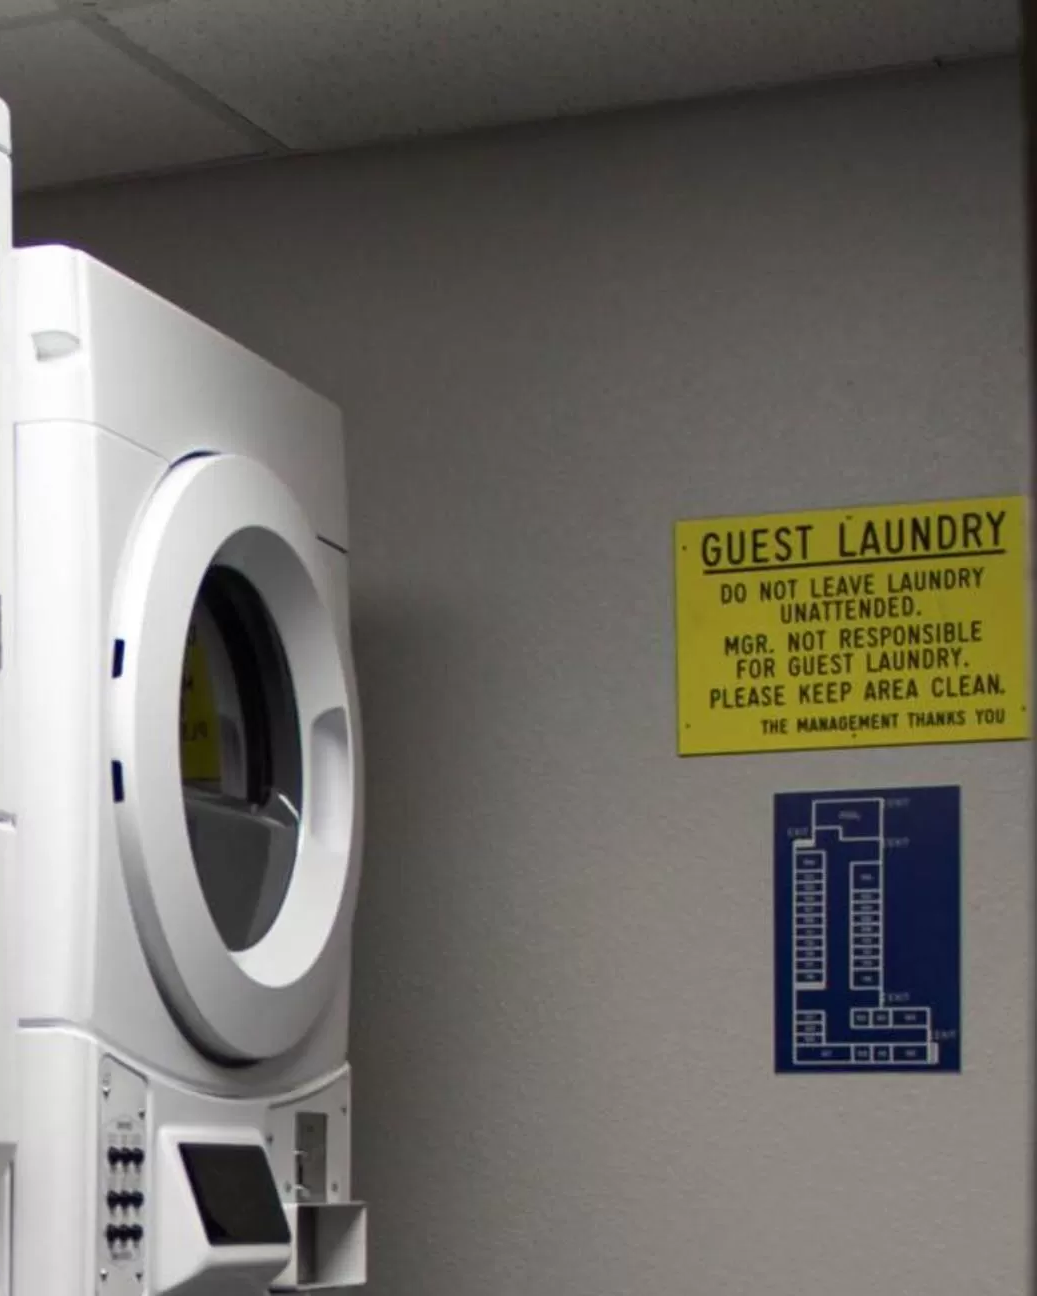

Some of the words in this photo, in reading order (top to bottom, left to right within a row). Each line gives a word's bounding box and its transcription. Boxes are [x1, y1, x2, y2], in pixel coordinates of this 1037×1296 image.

[701, 525, 813, 567] GUEST
[839, 511, 1006, 557] LAUNDRY
[720, 583, 747, 605] DO
[759, 579, 798, 602] NOT
[810, 574, 875, 599] LEAVE
[887, 566, 985, 595] LAUNDRY
[780, 596, 922, 624] UNATTENDED.
[724, 634, 775, 656] MGR.
[787, 630, 827, 652] NOT
[839, 620, 983, 649] RESPONSIBLE
[736, 658, 776, 680] FOR
[787, 653, 854, 677] GUEST
[866, 648, 970, 673] LAUNDRY.
[709, 685, 786, 709] PLEASE
[798, 682, 853, 704] KEEP
[864, 678, 919, 701] AREA
[931, 674, 1006, 698] CLEAN.
[761, 719, 788, 734] THE
[796, 713, 899, 733] MANAGEMENT
[907, 711, 966, 727] THANKS
[975, 708, 1006, 725] YOU
